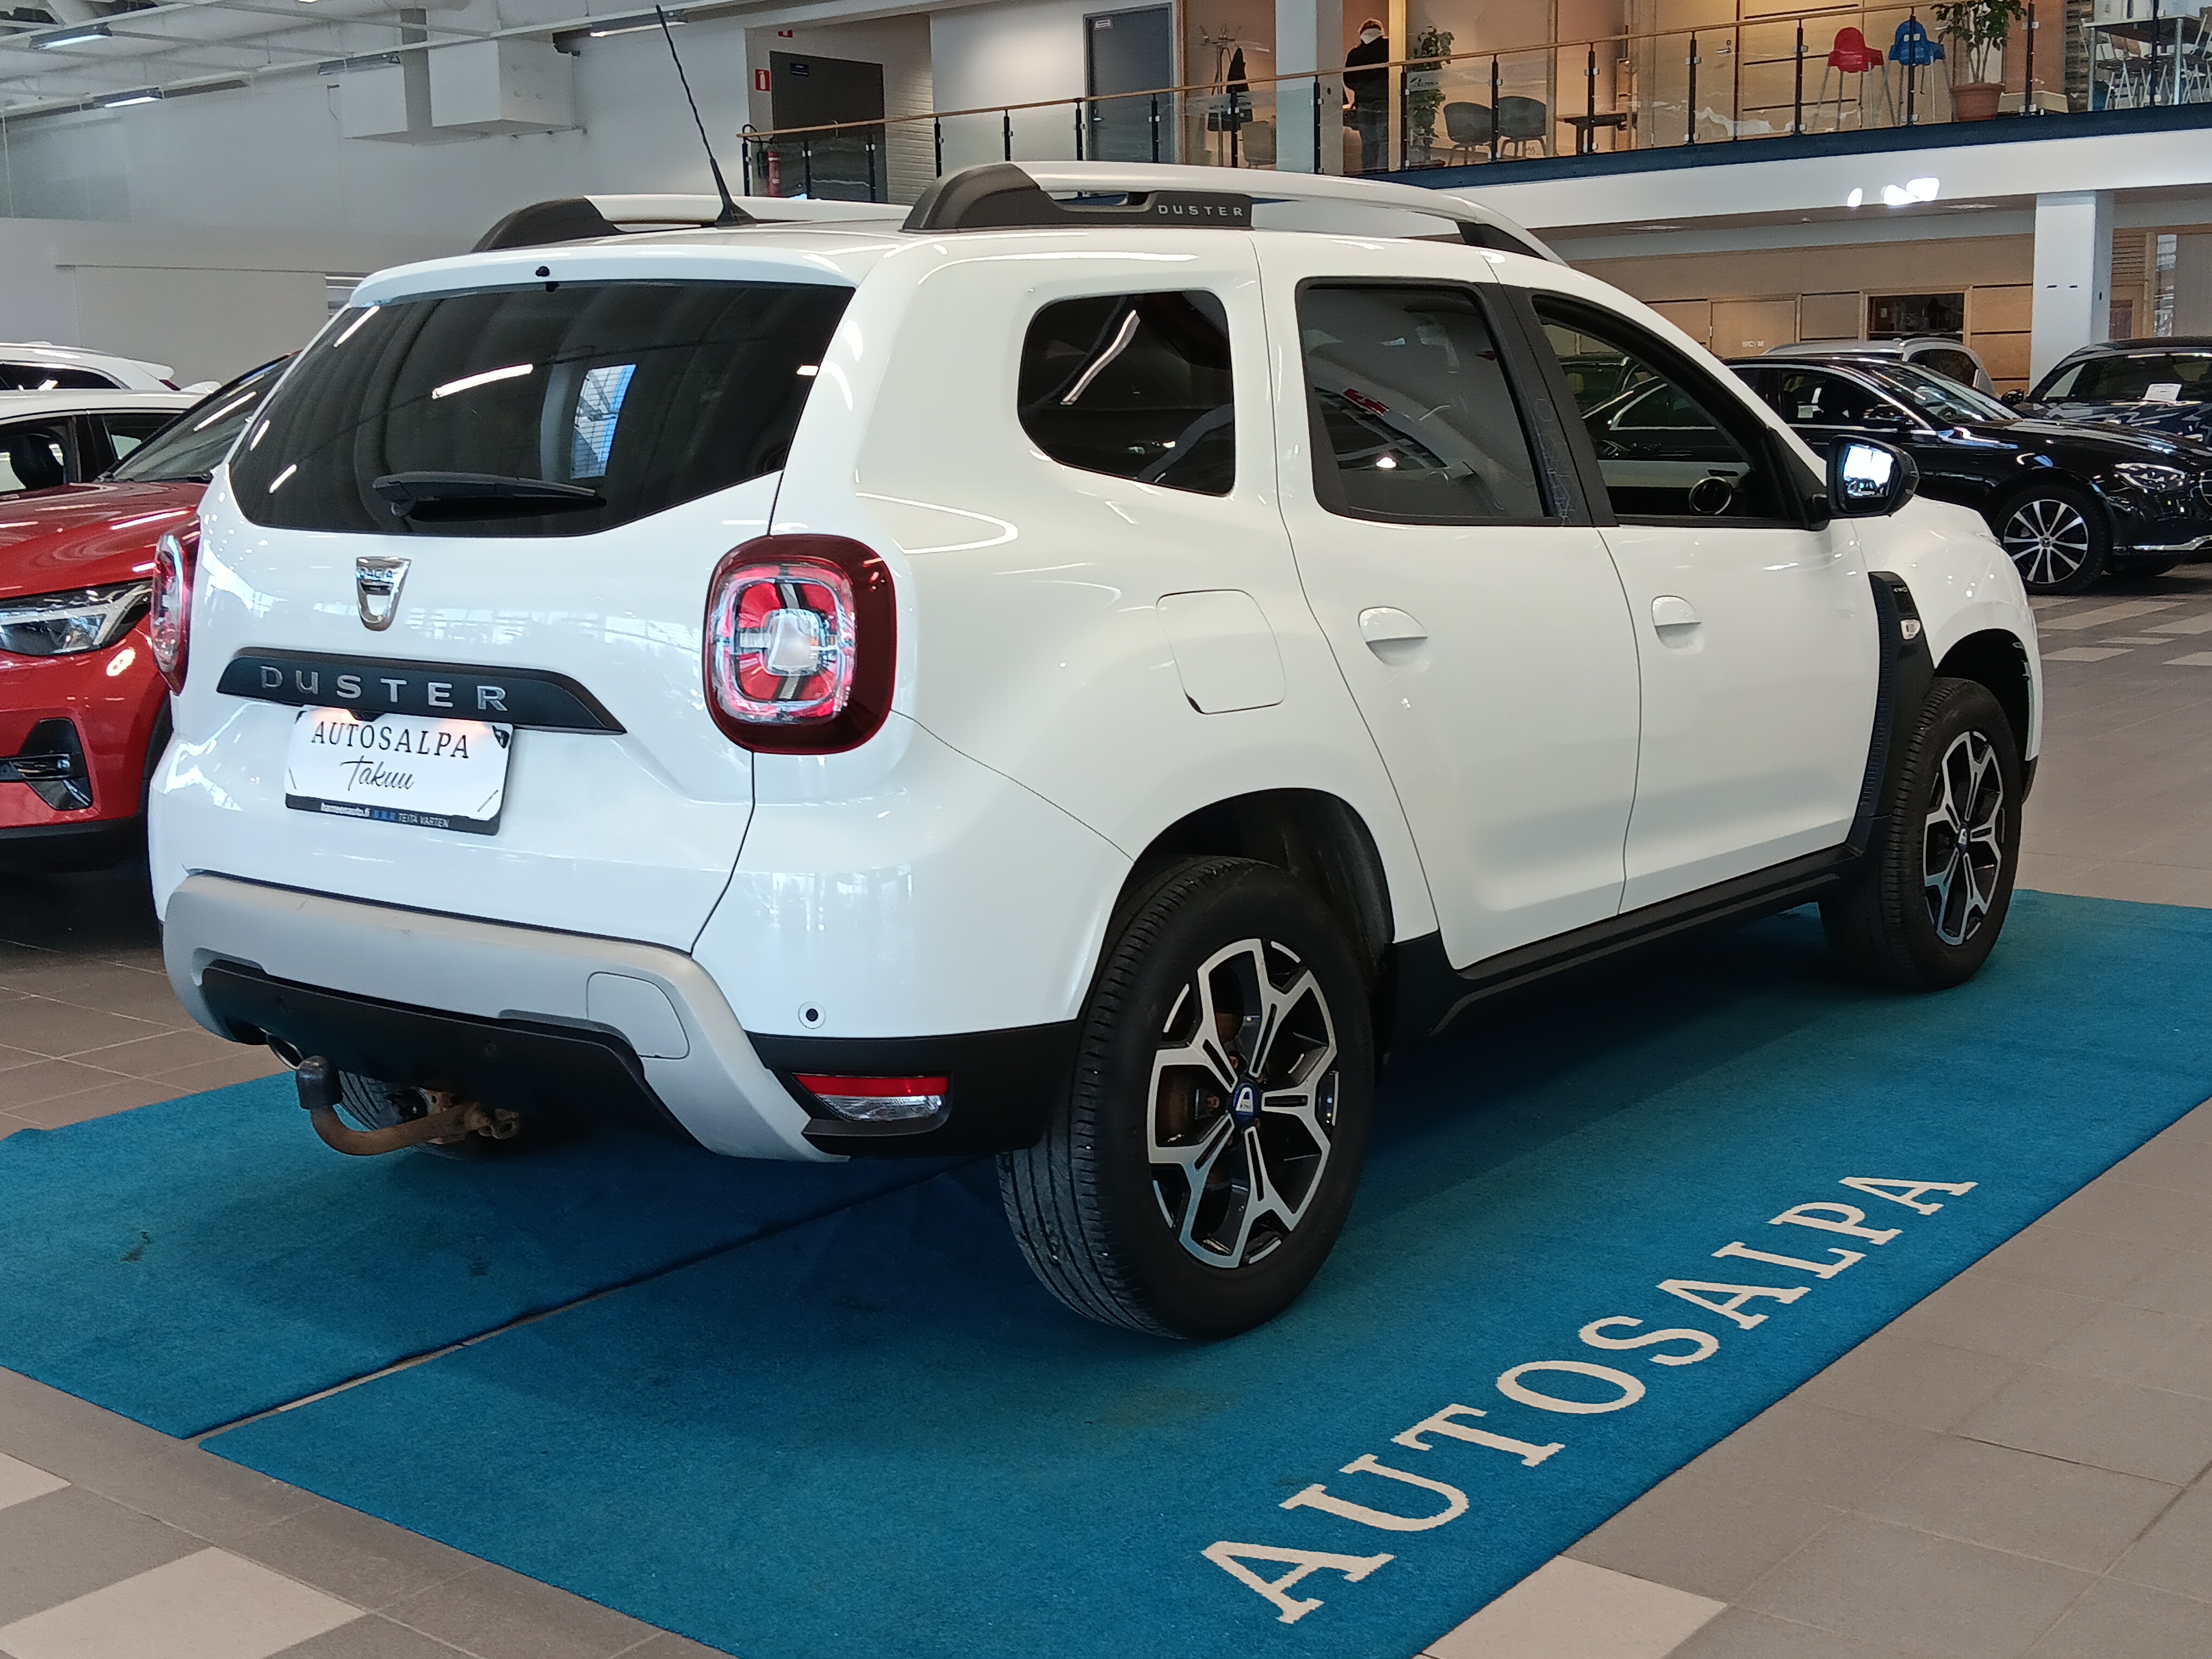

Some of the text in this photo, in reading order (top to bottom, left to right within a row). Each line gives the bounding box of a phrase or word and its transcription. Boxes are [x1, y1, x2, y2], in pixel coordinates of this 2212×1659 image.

[1157, 204, 1243, 216] DUSTER
[260, 665, 509, 711] DUSTER
[311, 721, 470, 759] AUTOSALPA
[339, 755, 415, 791] Takuu
[1200, 1175, 1979, 1625] AUTOSALPA
